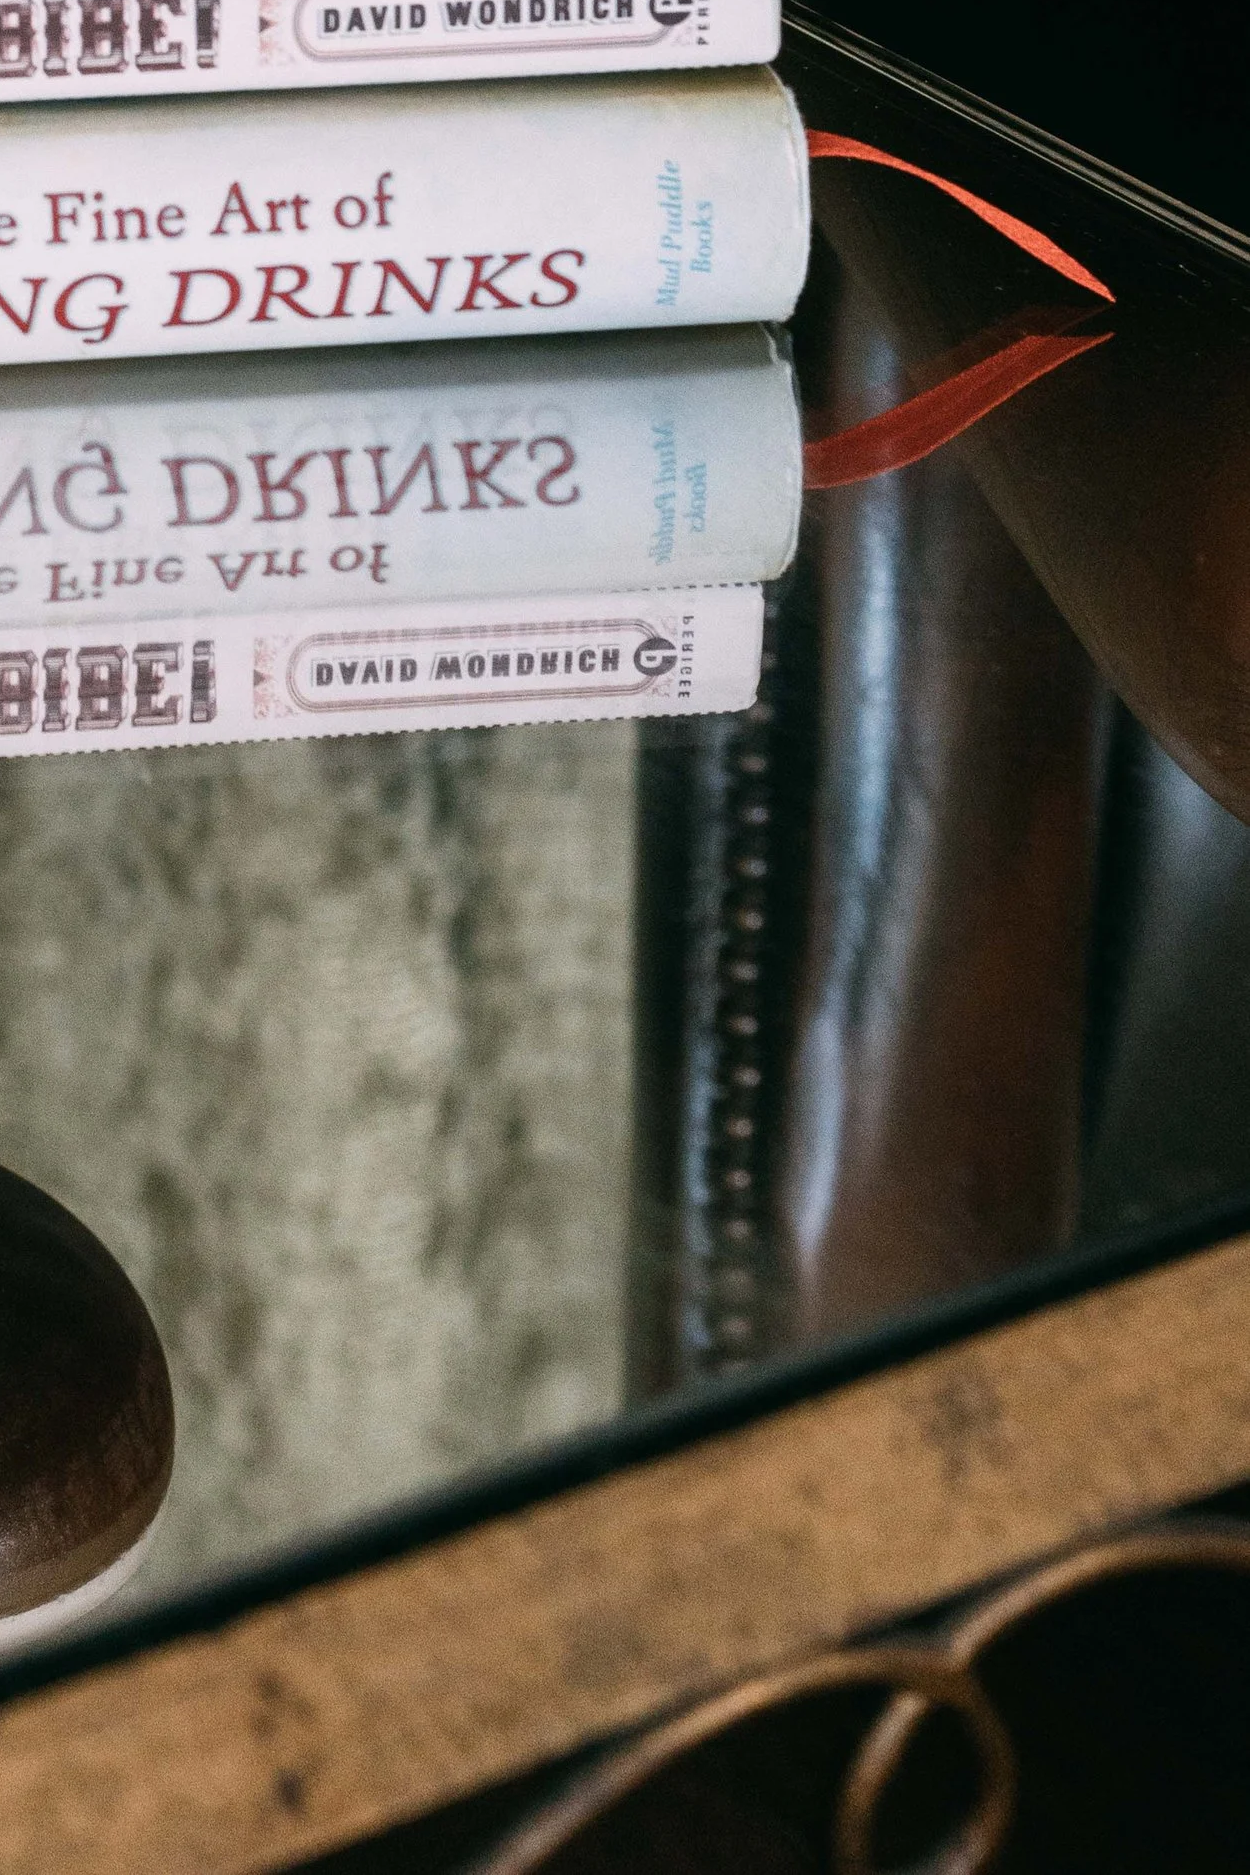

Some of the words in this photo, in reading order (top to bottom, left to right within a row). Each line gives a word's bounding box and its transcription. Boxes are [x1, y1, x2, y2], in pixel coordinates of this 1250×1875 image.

[322, 4, 428, 35] DAVID
[44, 190, 186, 245] Fine
[210, 180, 310, 235] Art
[333, 171, 396, 229] of
[657, 159, 683, 250] Puddle
[690, 200, 713, 273] Books
[161, 249, 586, 327] DRINKS
[655, 258, 681, 306] Mud
